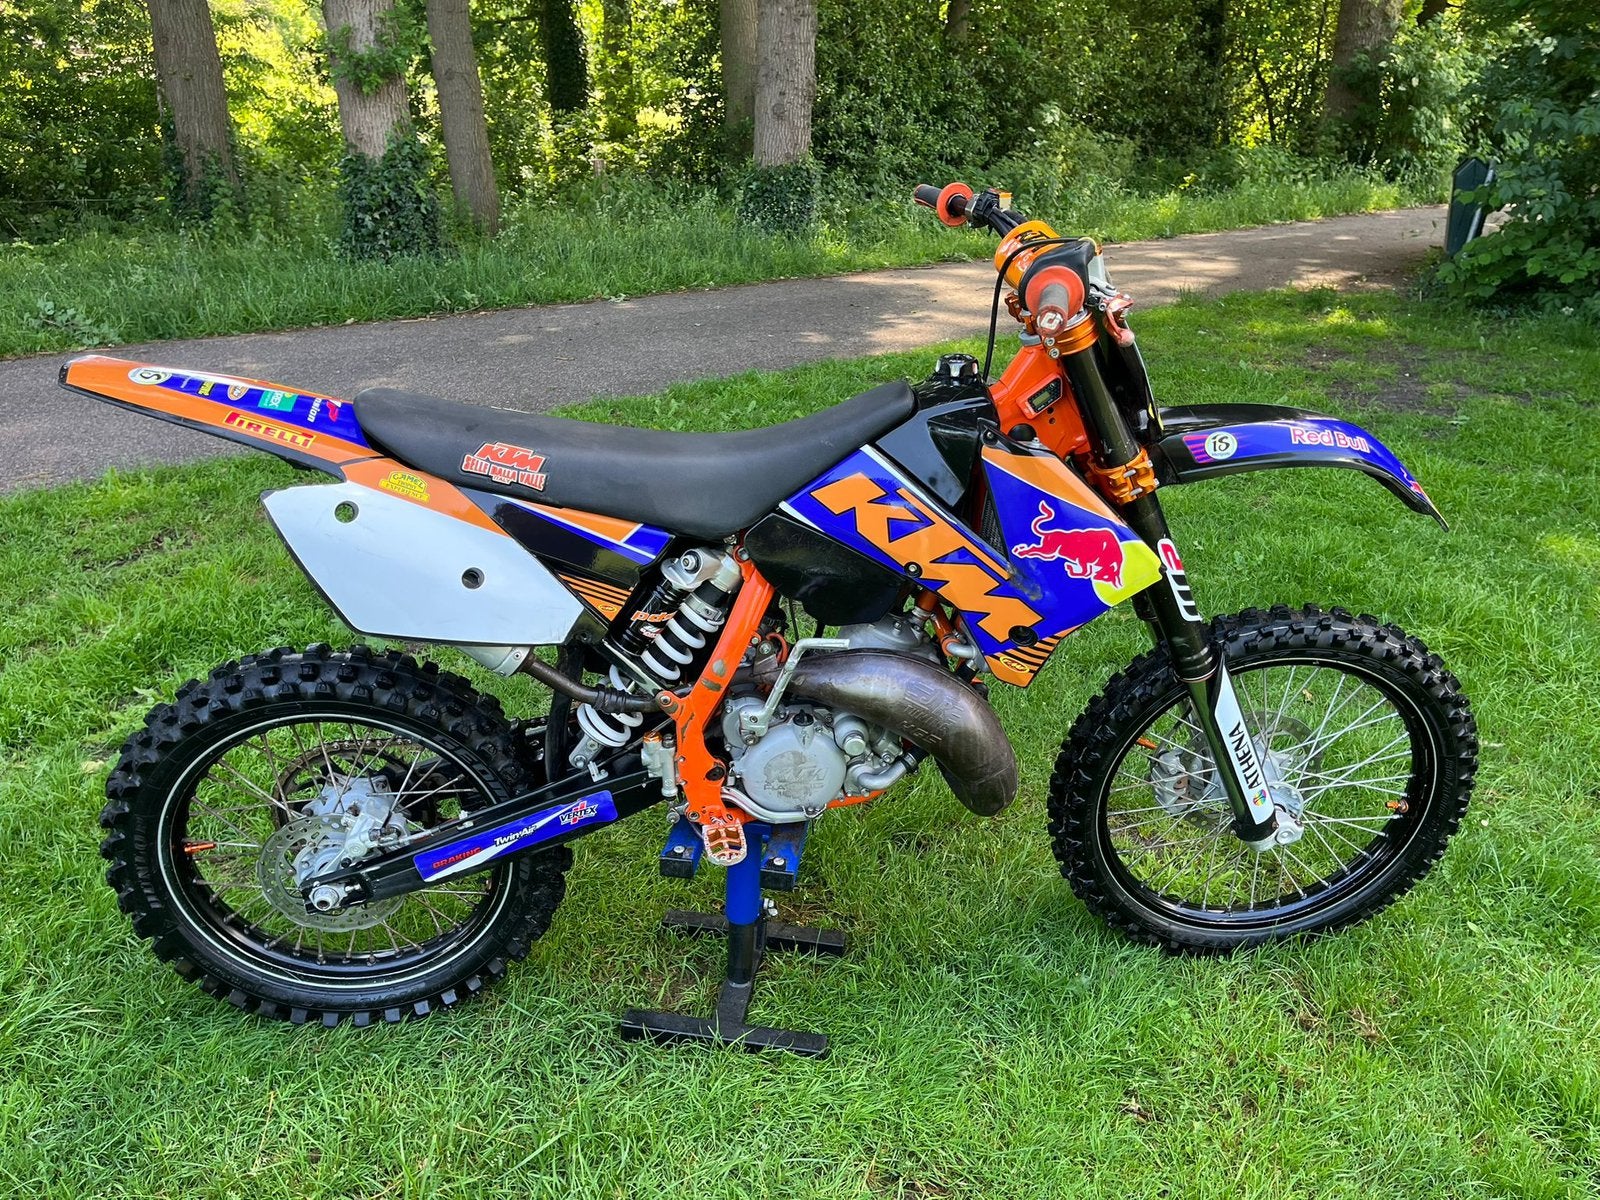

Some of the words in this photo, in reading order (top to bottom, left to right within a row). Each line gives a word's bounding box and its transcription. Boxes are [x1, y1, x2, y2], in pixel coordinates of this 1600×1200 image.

[224, 411, 314, 448] PIRELLI
[1290, 426, 1334, 447] Red
[1334, 431, 1370, 453] Bull
[474, 442, 545, 472] KTM
[393, 473, 425, 489] CAMEL
[463, 455, 490, 474] SELLE
[519, 472, 546, 490] VALLE
[810, 472, 1044, 644] KTM
[1228, 721, 1262, 790] ATHENA
[560, 805, 597, 822] VERTEX
[432, 847, 481, 869] BRAKING
